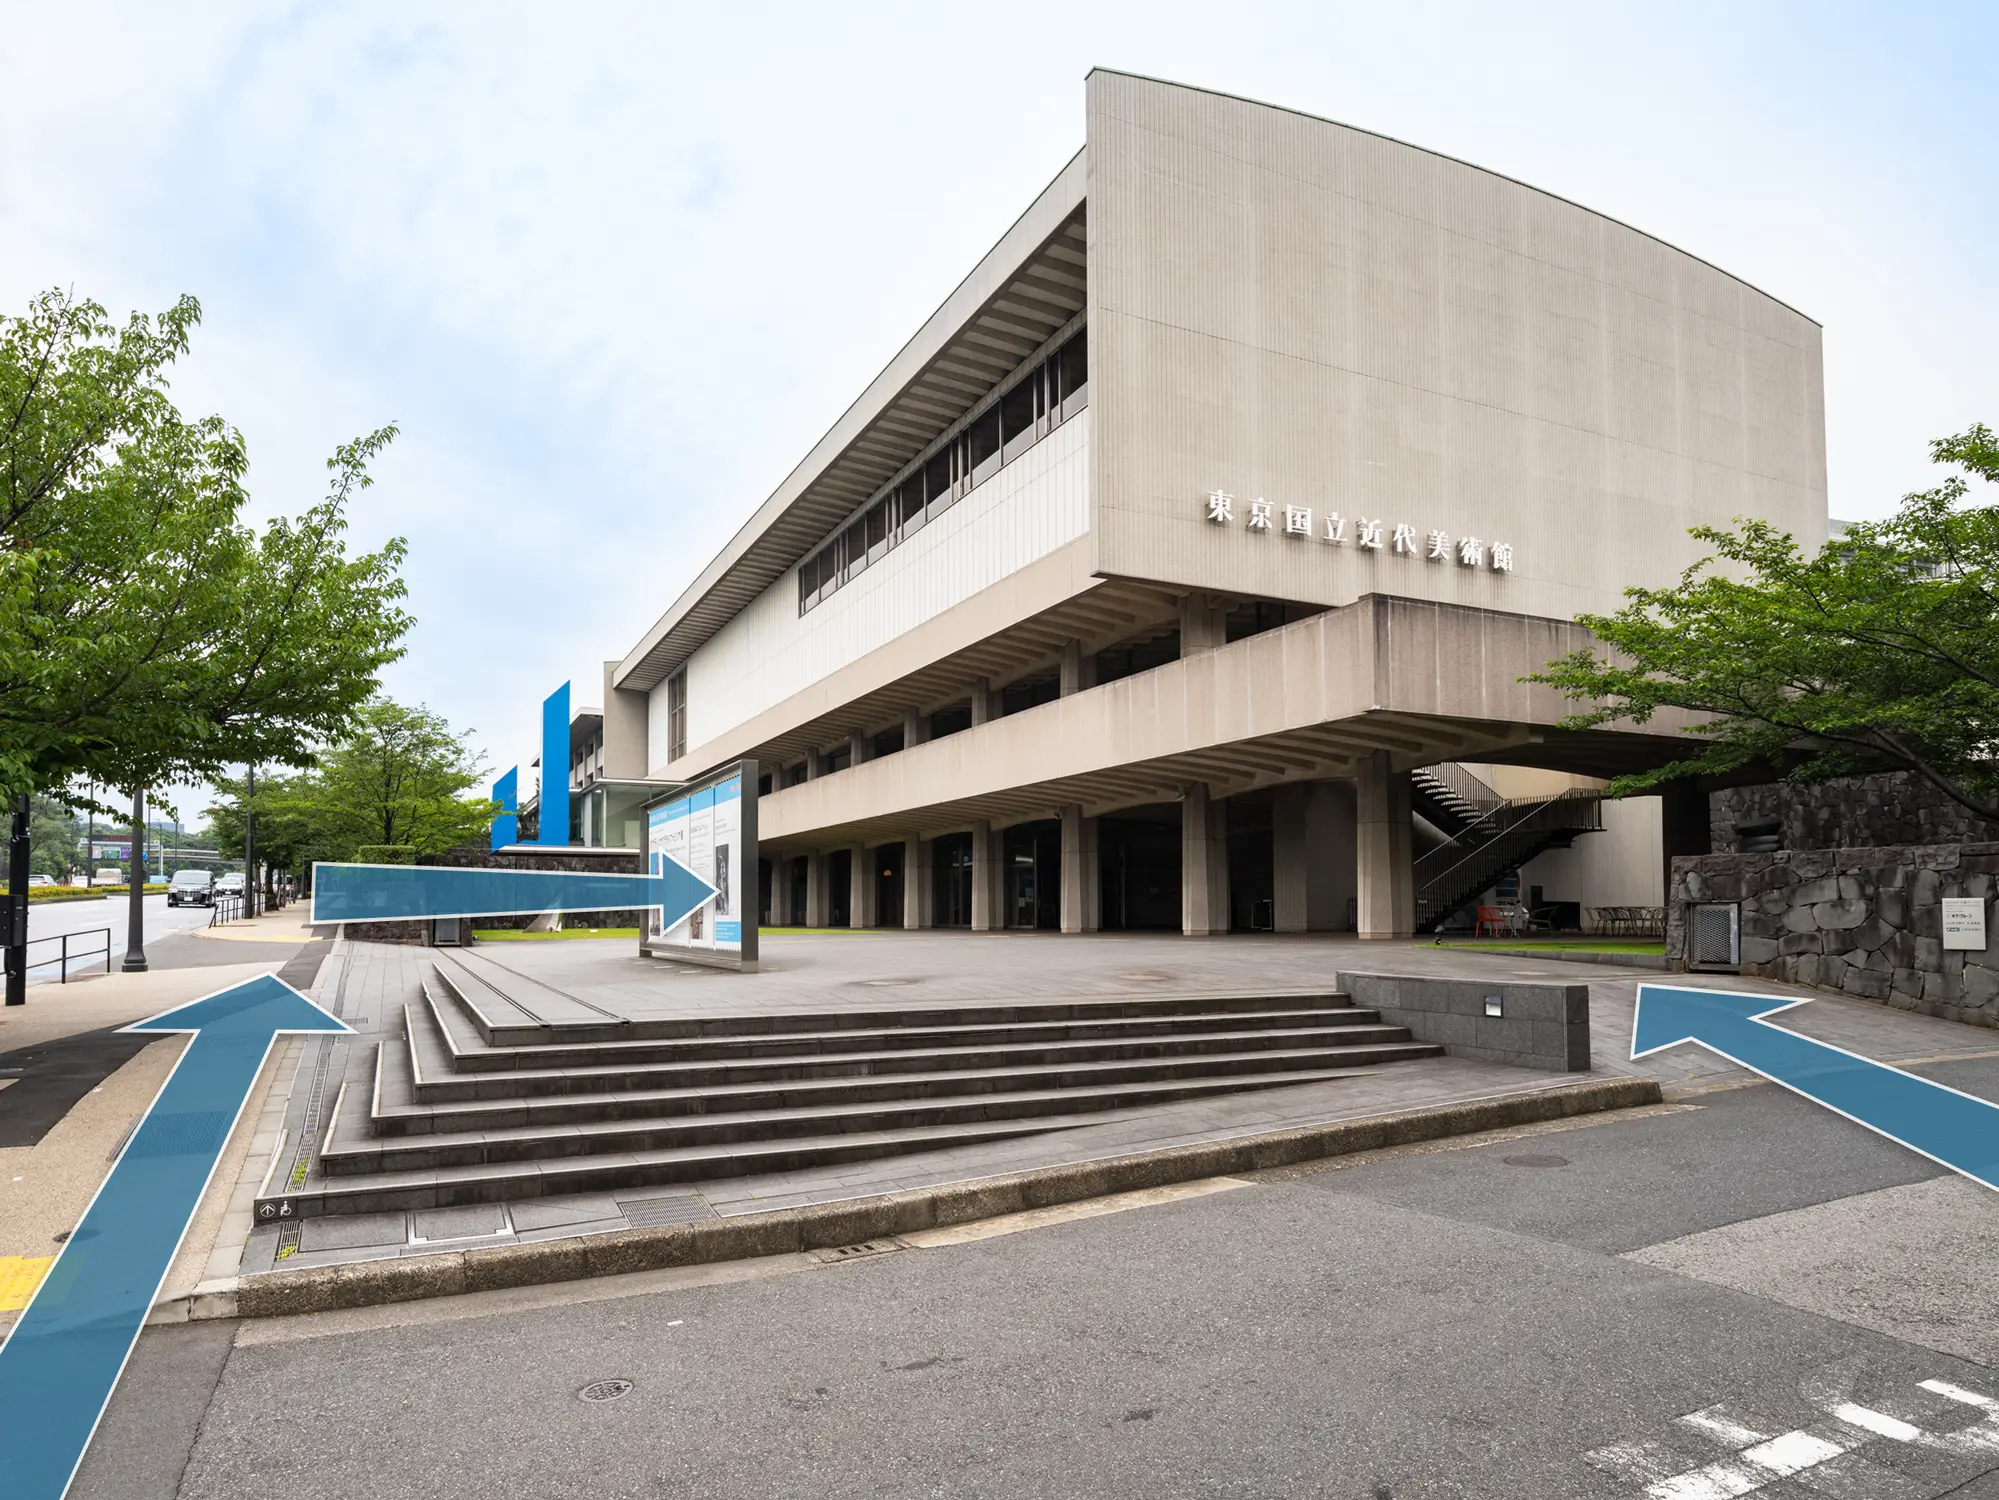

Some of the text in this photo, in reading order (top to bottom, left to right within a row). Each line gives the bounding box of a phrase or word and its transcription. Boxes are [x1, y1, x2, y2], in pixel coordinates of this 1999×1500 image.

[1207, 489, 1513, 572] 東京国立近代美術館
